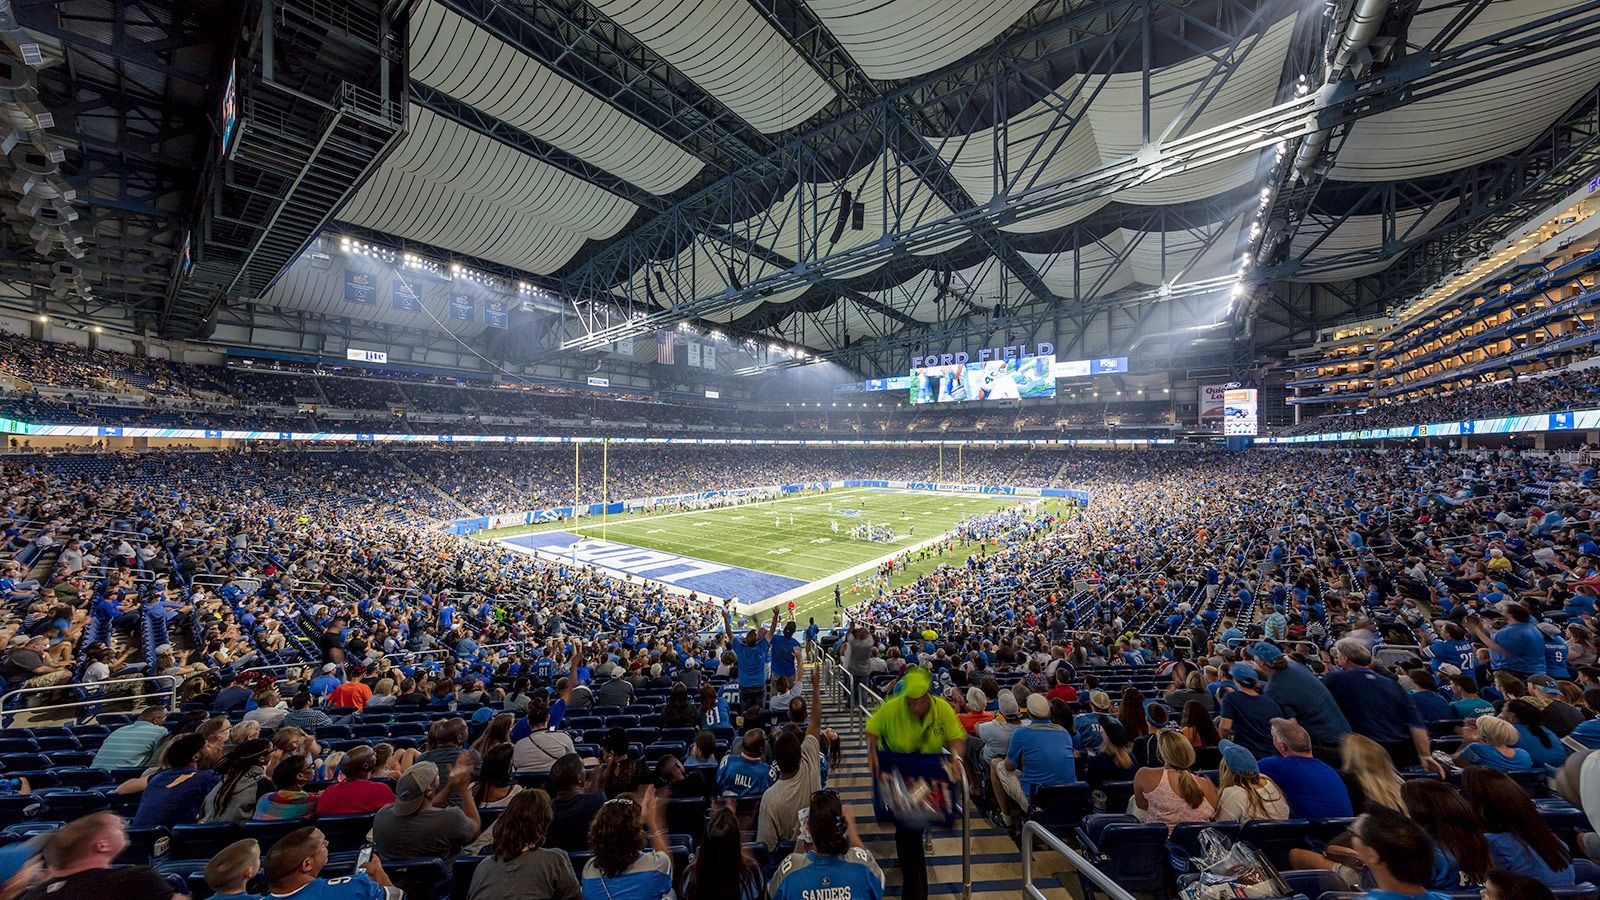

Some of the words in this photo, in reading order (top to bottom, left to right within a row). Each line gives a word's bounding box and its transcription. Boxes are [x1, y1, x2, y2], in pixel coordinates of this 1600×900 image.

[366, 351, 384, 361] Lite
[912, 352, 969, 368] FORD
[979, 342, 1054, 361] FIELD
[705, 706, 720, 725] 81
[734, 773, 752, 788] HALL
[802, 886, 851, 900] SANDERS
